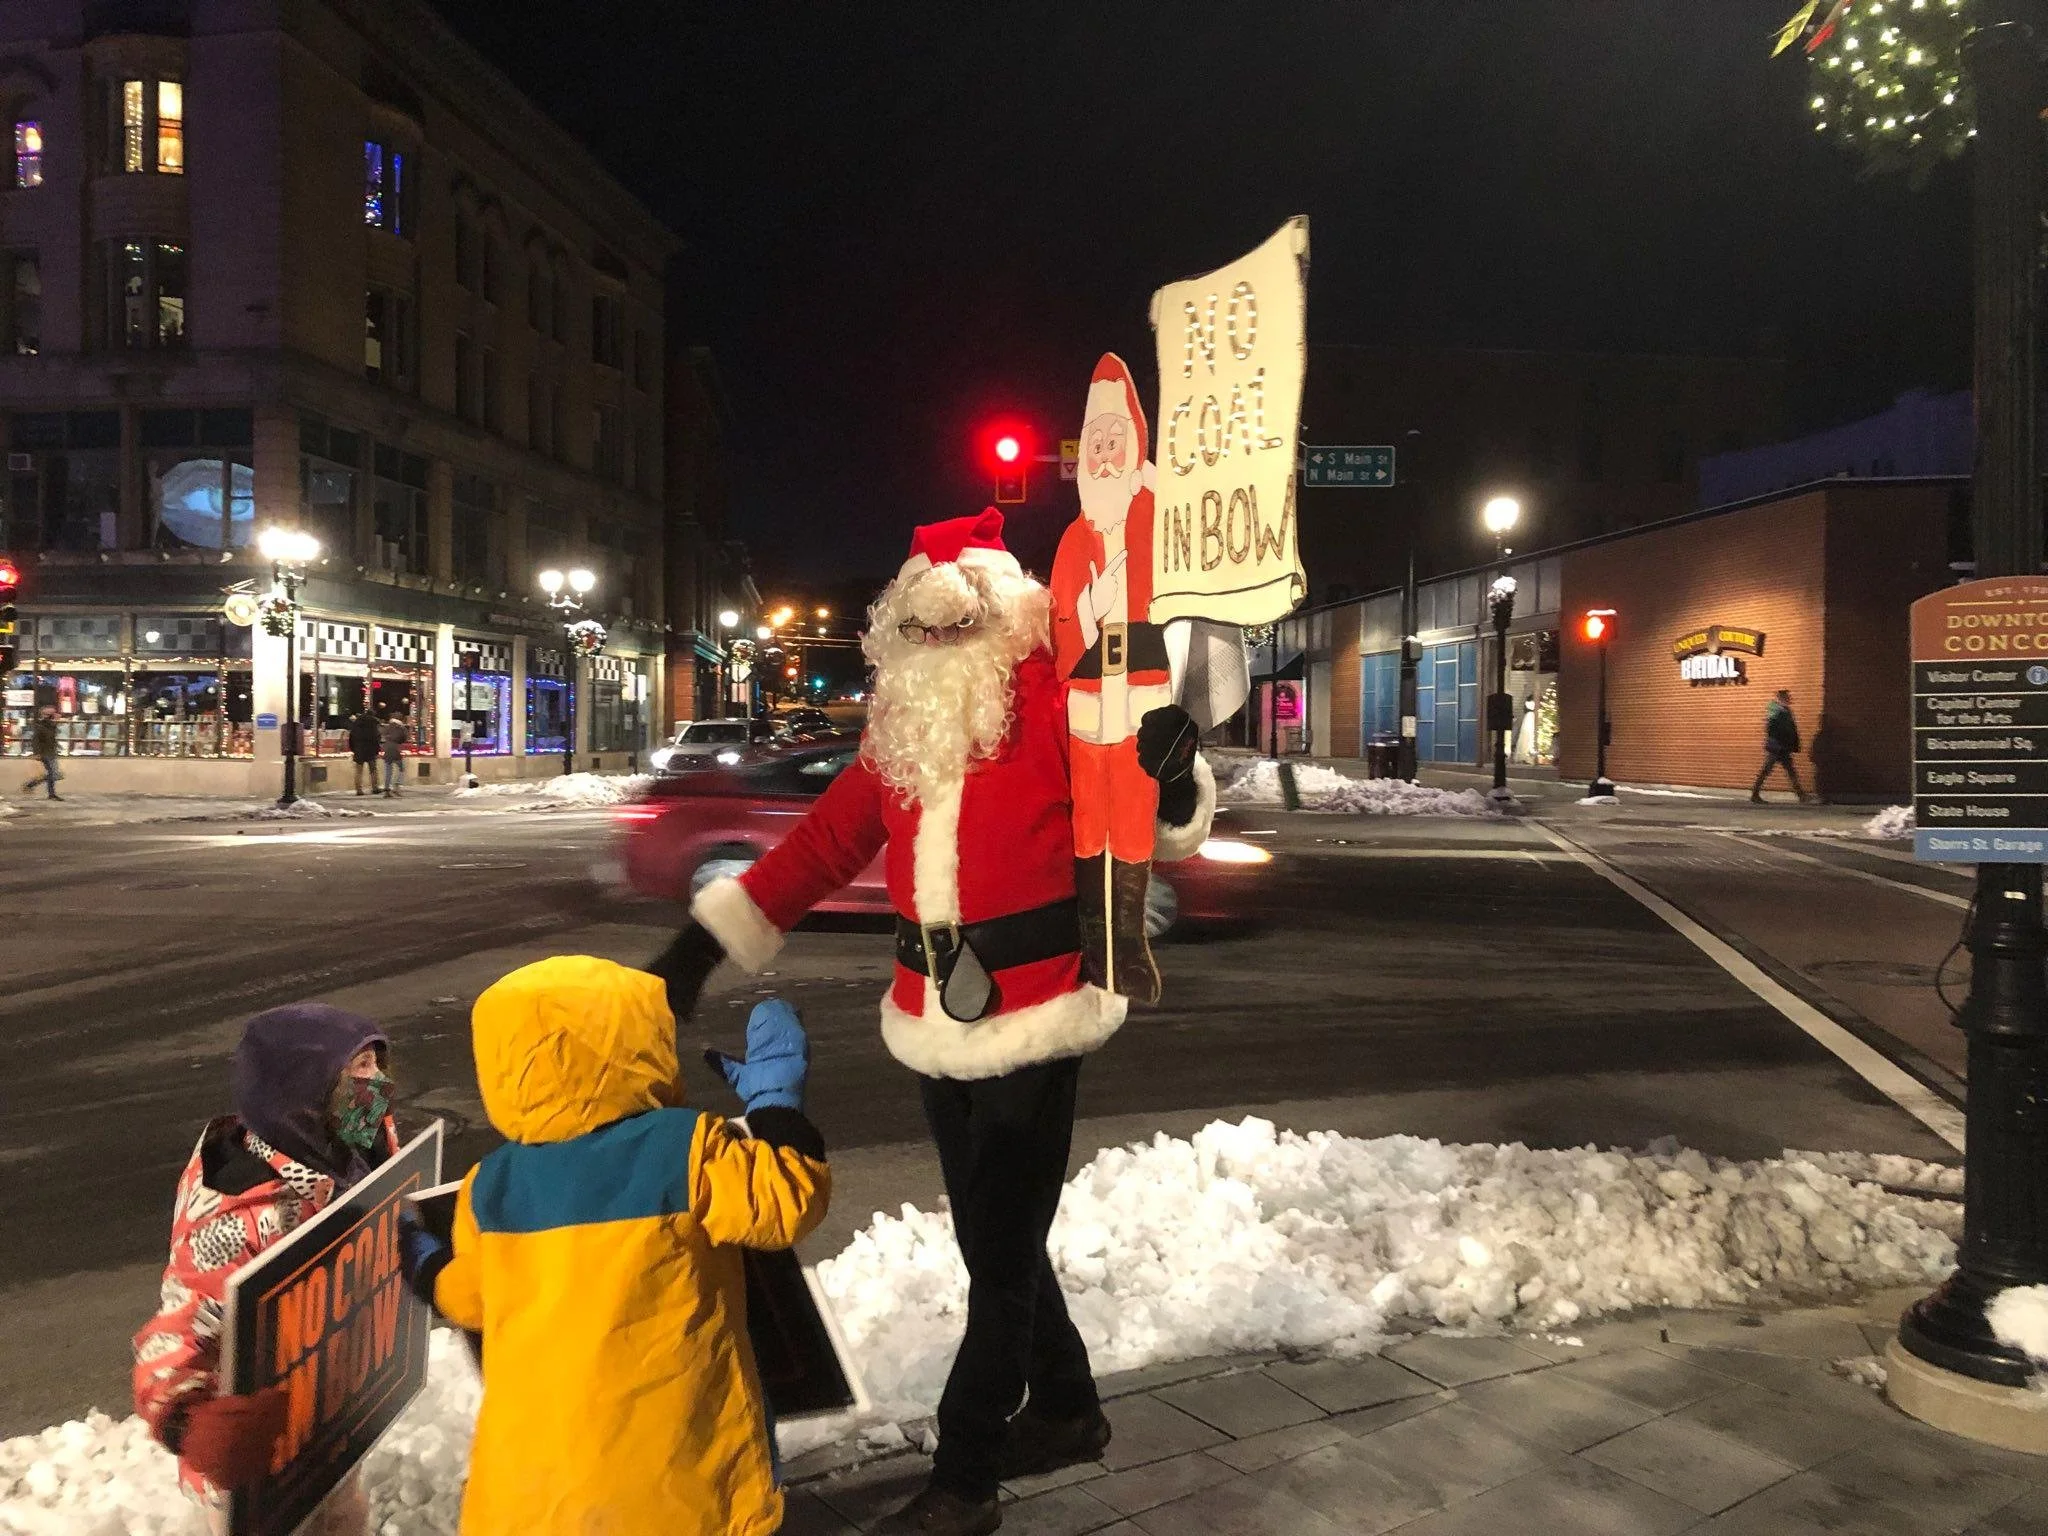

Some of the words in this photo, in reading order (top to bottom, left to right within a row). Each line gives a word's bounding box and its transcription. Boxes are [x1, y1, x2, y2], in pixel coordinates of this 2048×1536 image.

[1183, 281, 1258, 378] NO
[1168, 367, 1283, 477] COAL
[1328, 452, 1337, 465] S
[1344, 452, 1372, 465] Main
[1327, 469, 1354, 481] Main
[1163, 502, 1192, 573] IN
[1201, 474, 1294, 572] BOW
[1681, 654, 1740, 680] BRIDAL
[1927, 670, 1969, 683] Visitor
[1972, 669, 2018, 682] Center
[1976, 696, 2021, 709] Center
[1936, 713, 1955, 724] for
[1958, 712, 1981, 724] the
[1983, 711, 2012, 724] Arts
[1927, 738, 2011, 750] Bicentennial
[1927, 771, 1965, 786] Eagle
[1967, 771, 2017, 786] Square
[1928, 804, 1964, 817] State
[1966, 804, 2010, 817] House
[1993, 838, 2043, 853] Garage
[276, 1266, 328, 1374] NO
[333, 1200, 400, 1322] COAL
